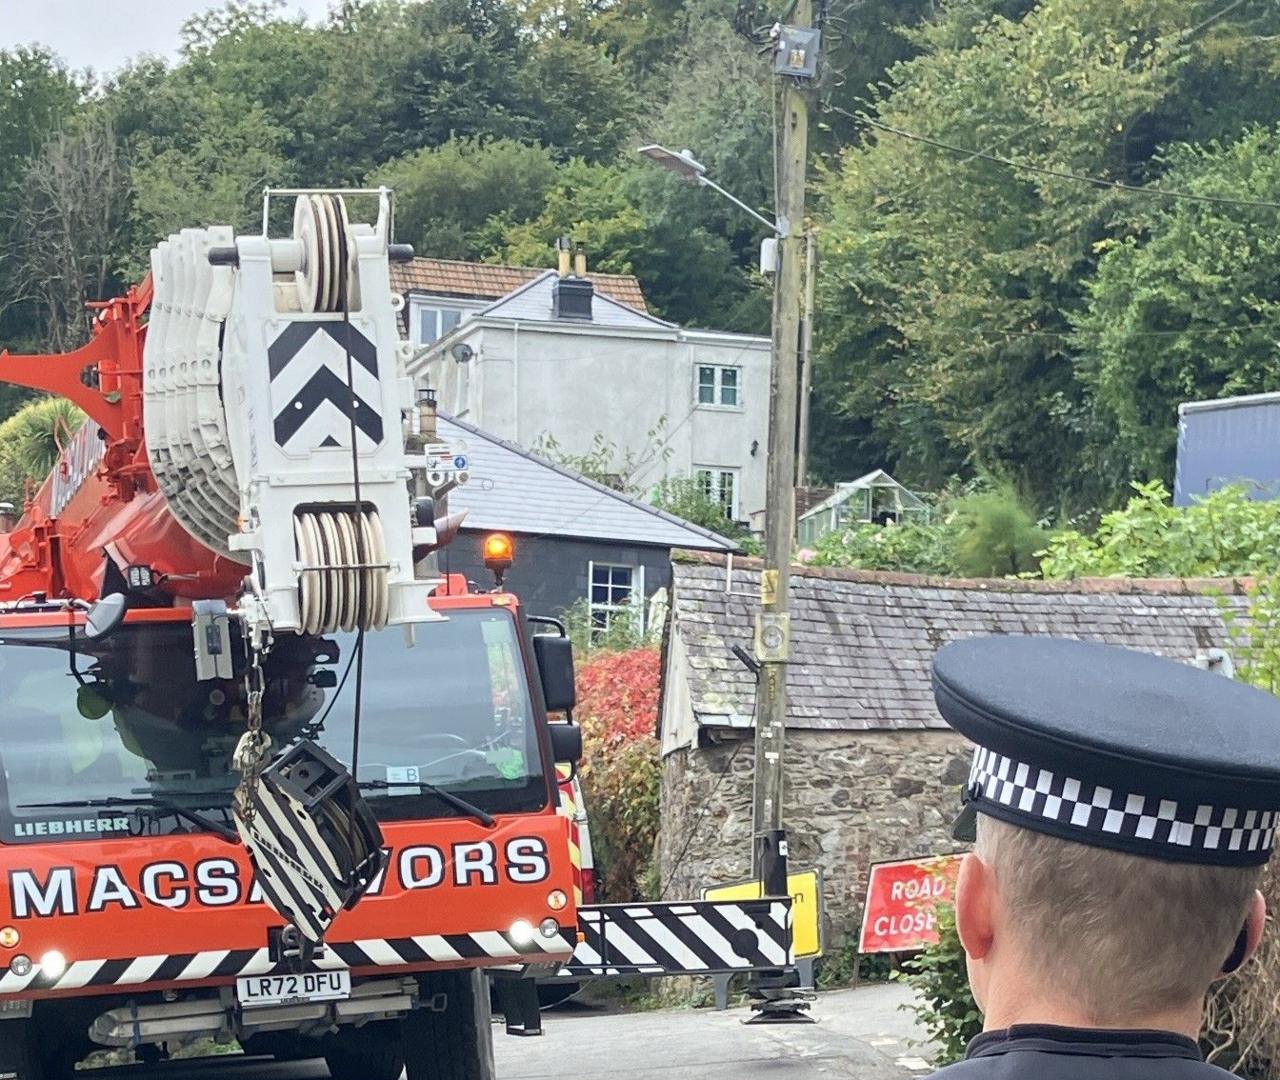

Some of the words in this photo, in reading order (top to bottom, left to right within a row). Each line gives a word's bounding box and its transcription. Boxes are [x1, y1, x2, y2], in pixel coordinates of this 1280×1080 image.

[14, 817, 130, 837] LIEBHERR
[8, 836, 550, 919] MACSORS
[890, 876, 946, 901] ROAD
[874, 911, 938, 937] CLOSE
[246, 976, 298, 997] LR72
[303, 973, 341, 993] DFU
